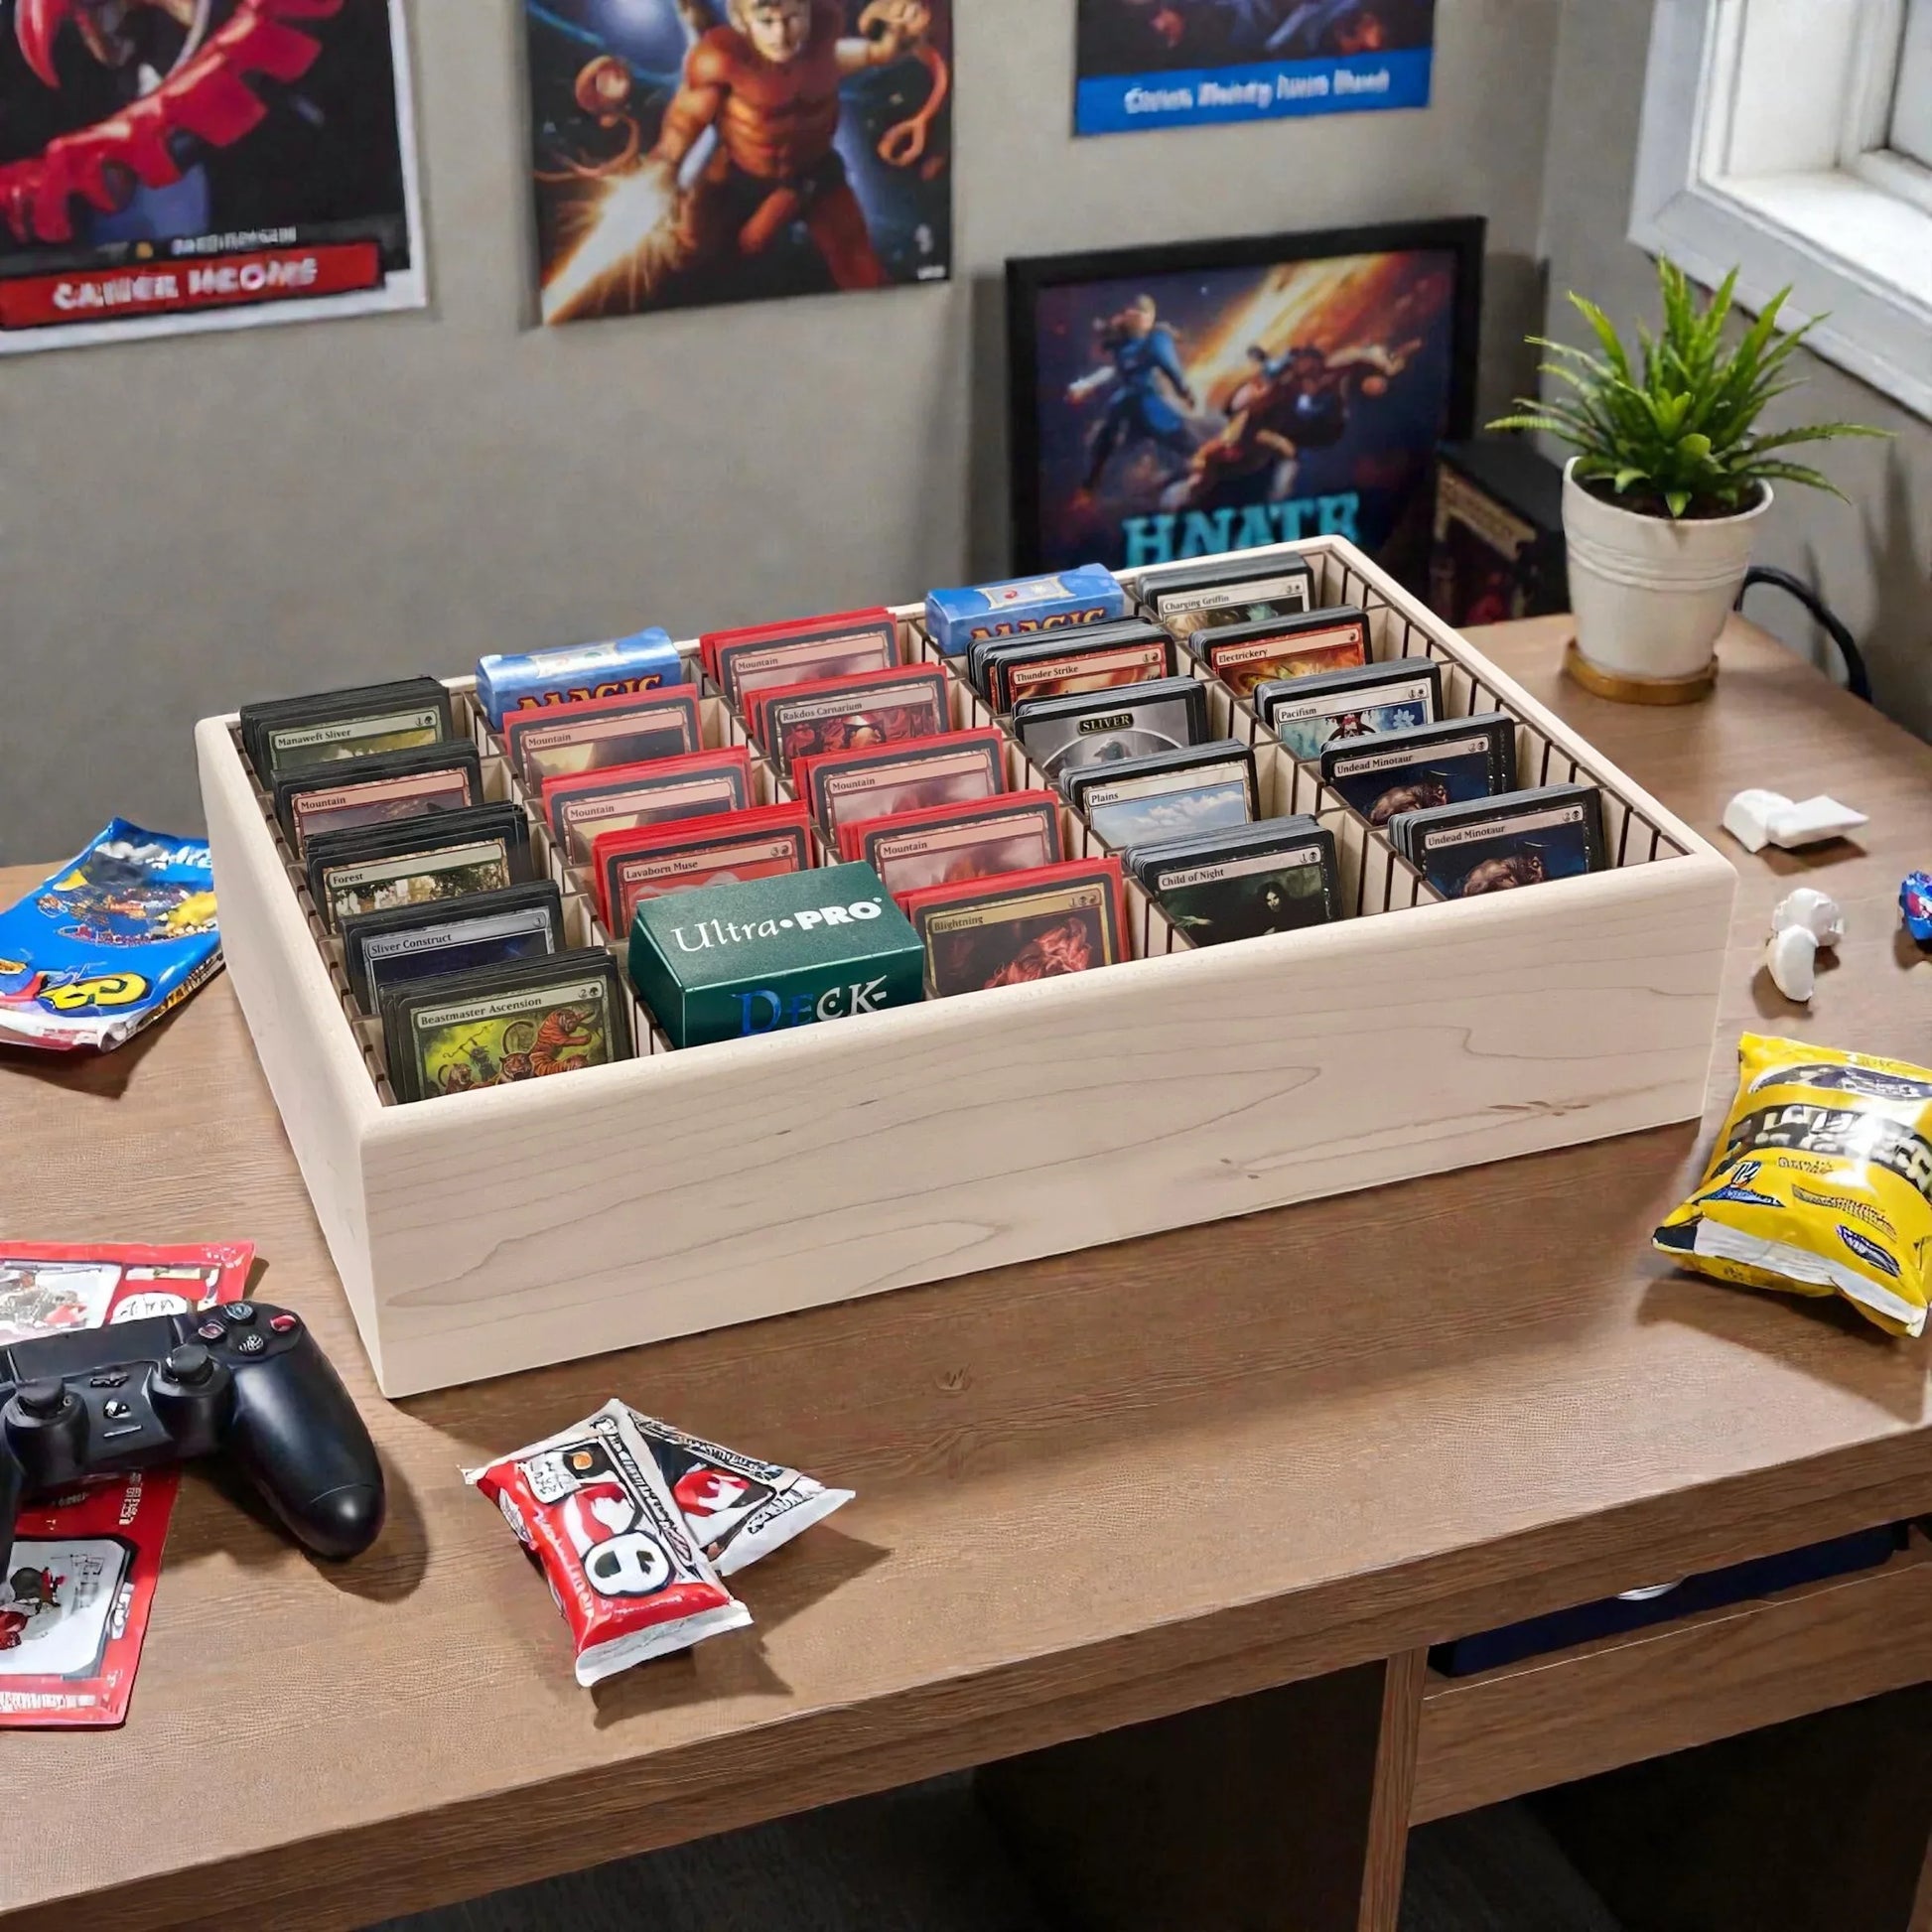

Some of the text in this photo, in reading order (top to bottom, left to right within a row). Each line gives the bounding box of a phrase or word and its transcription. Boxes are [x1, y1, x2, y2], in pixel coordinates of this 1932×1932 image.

[1165, 600, 1200, 613] Charging
[1202, 595, 1229, 607] Griffin
[738, 657, 778, 670] Mountain
[1218, 648, 1268, 663] Electrickery
[1016, 670, 1052, 683] Thunder
[1054, 664, 1079, 676] Strike
[782, 702, 863, 722] Rakdos Carnarium
[1281, 706, 1317, 720] Pacifism
[1082, 715, 1131, 733] SLIVER
[277, 731, 324, 748] Manaweft
[325, 728, 351, 740] Sliver
[528, 733, 572, 748] Mountain
[1336, 759, 1371, 774] Undead
[1372, 754, 1413, 768] Minotaur
[832, 777, 876, 791] Mountain
[300, 797, 346, 811] Mountain
[1091, 791, 1119, 804] Plains
[570, 804, 615, 818] Mountain
[1428, 831, 1462, 846] Undead
[1464, 825, 1505, 840] Minotaur
[883, 841, 927, 856] Mountain
[626, 864, 671, 880] Lavaborn
[674, 860, 698, 872] Muse
[1162, 875, 1185, 888] Child
[1187, 872, 1198, 883] of
[1199, 869, 1224, 882] Night
[333, 874, 363, 885] Forest
[934, 915, 984, 931] Blightning
[371, 942, 400, 955] Sliver
[402, 934, 452, 949] Construct
[421, 1008, 486, 1027] Beastmaster
[488, 997, 542, 1014] Ascension
